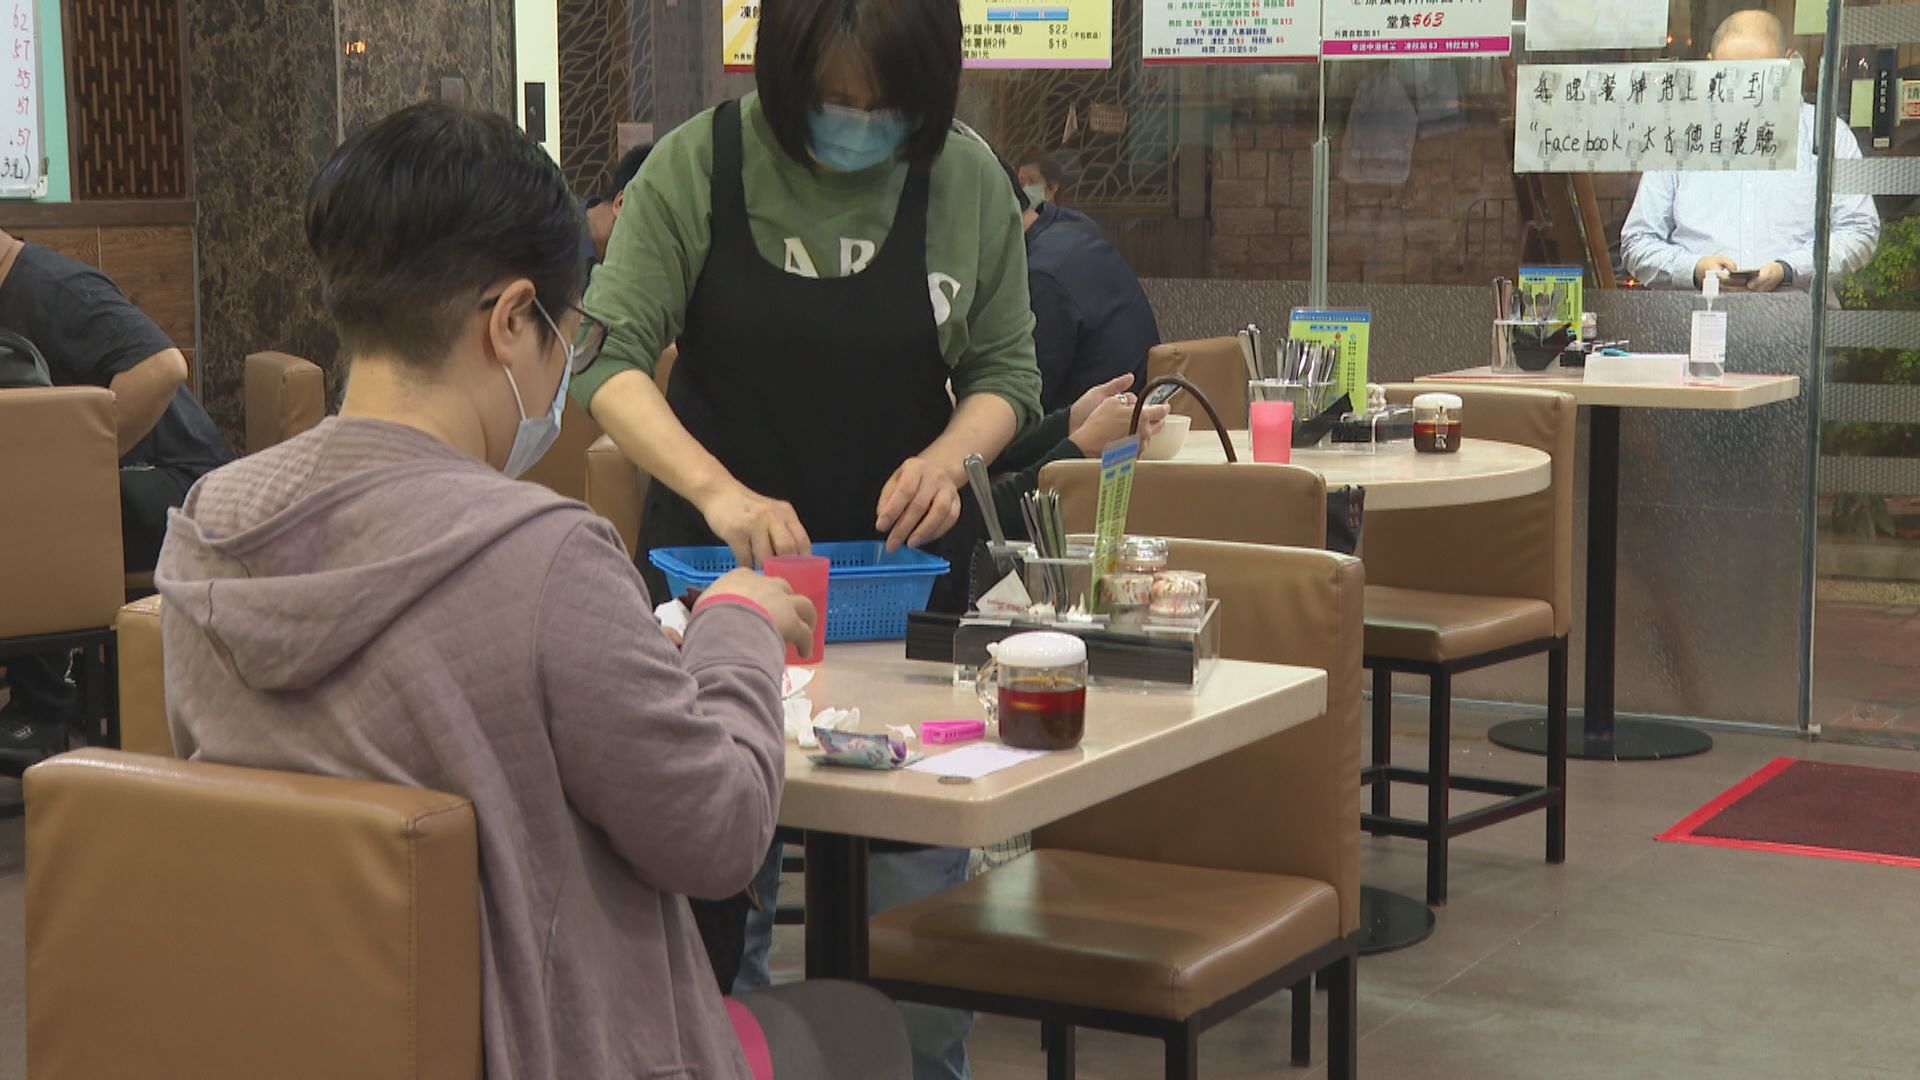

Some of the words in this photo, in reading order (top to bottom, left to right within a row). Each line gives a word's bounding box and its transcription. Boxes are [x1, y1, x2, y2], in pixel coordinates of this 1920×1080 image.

[13, 3, 29, 32] 62
[1049, 24, 1067, 35] $22
[1049, 38, 1067, 49] $18
